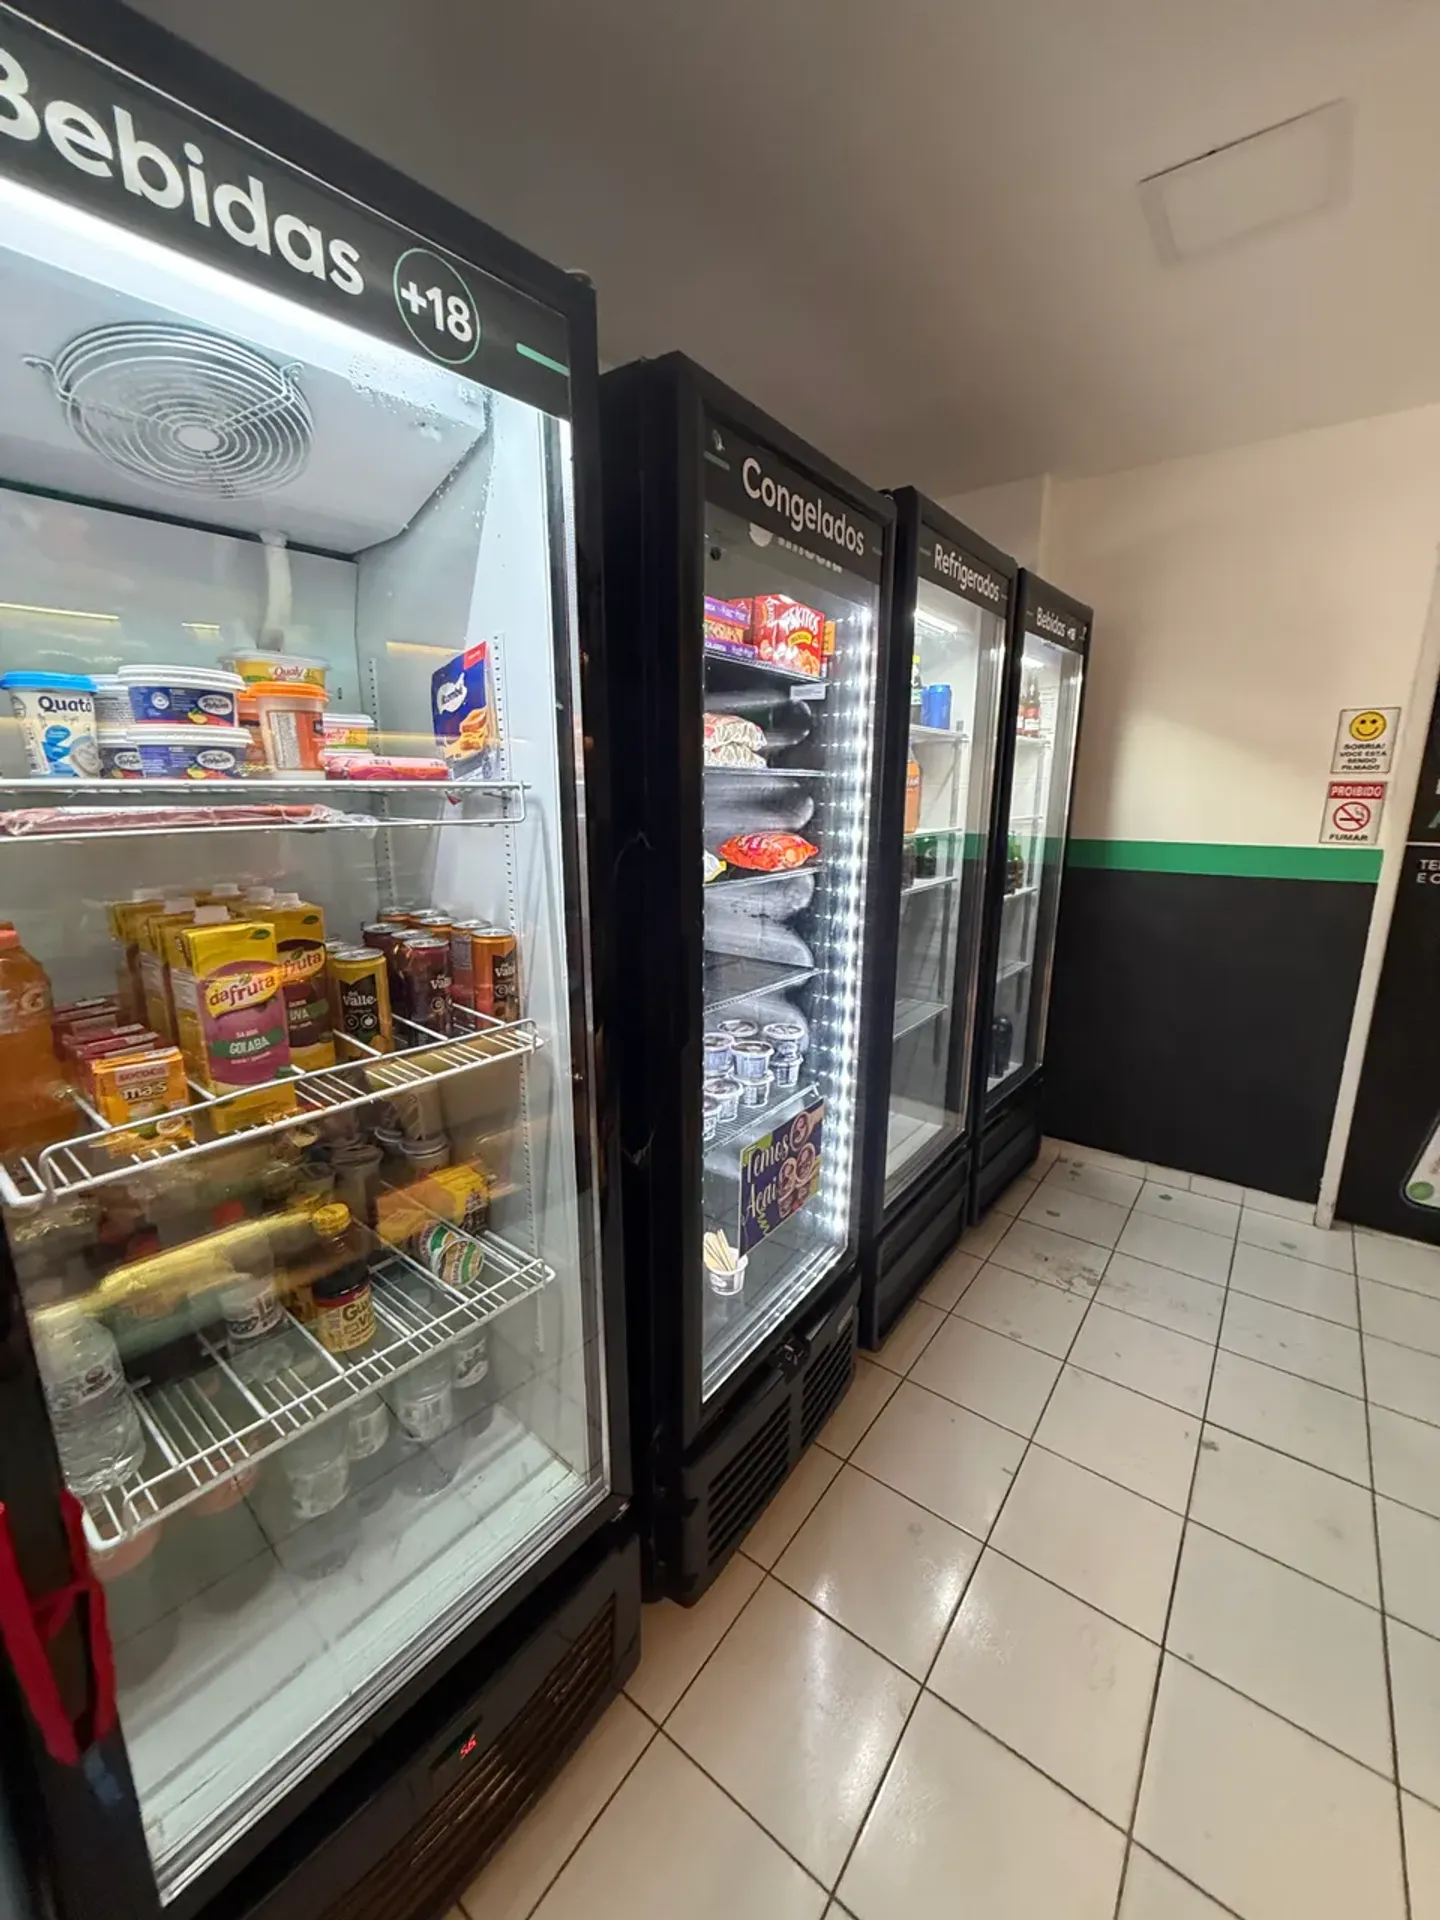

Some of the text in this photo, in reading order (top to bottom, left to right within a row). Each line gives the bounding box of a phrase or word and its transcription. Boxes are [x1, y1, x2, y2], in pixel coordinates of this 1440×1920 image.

[0, 46, 473, 343] Bebidas +18
[742, 457, 865, 556] Congelados
[934, 543, 1000, 602] Refrigerados
[1036, 607, 1066, 637] Bebidas
[274, 665, 304, 680] Qualy
[1331, 785, 1382, 797] PROIBIDO
[1329, 833, 1368, 841] FUMAR
[283, 951, 323, 977] fruta
[208, 975, 276, 1007] dafruta
[229, 1035, 271, 1055] GOIABA
